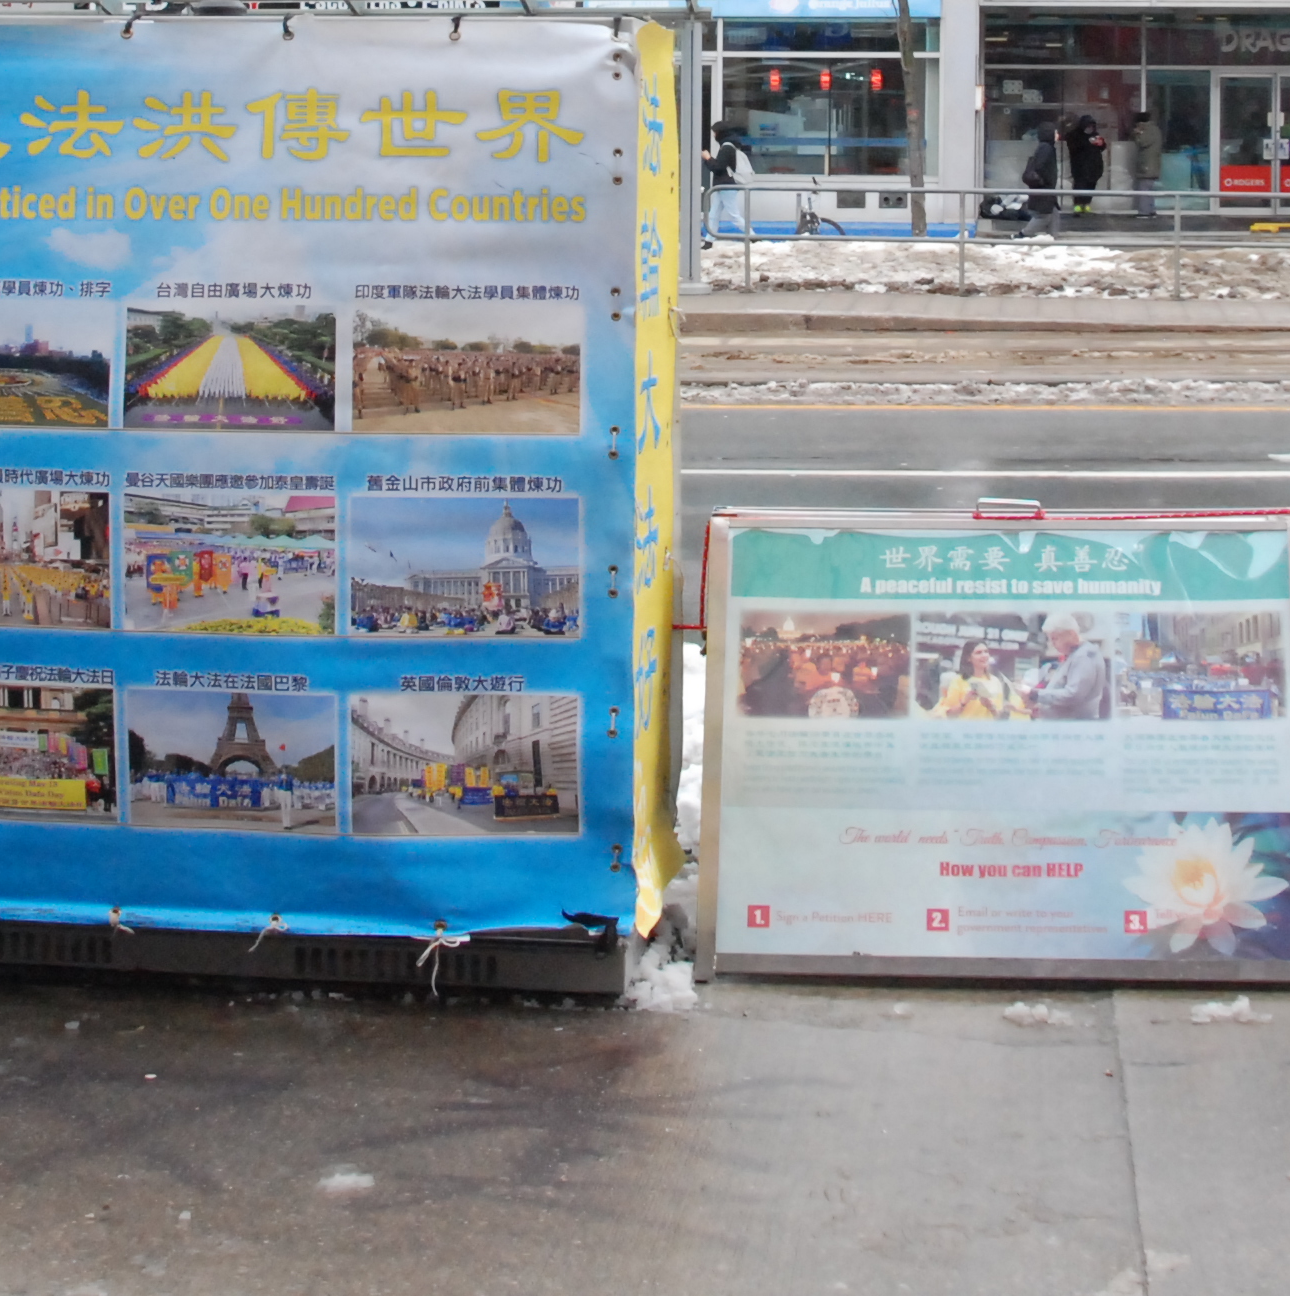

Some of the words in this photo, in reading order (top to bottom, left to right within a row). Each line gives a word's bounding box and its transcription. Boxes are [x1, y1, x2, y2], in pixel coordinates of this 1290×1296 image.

[85, 185, 114, 219] in
[123, 187, 201, 221] Over
[209, 187, 271, 221] One
[280, 186, 418, 222] Hundred
[427, 188, 587, 223] Countries
[879, 545, 1010, 573] 世界需要
[860, 577, 872, 594] A
[874, 577, 953, 596] peaceful
[956, 577, 1008, 595] resist
[1011, 578, 1029, 595] to
[1032, 580, 1074, 595] save
[1077, 579, 1162, 597] humanity
[839, 826, 870, 845] The
[874, 830, 910, 844] world
[918, 831, 949, 845] needs
[939, 862, 975, 877] How
[977, 864, 1008, 880] you
[1011, 864, 1043, 877] can
[1046, 862, 1085, 878] HELP
[754, 909, 766, 925] 1.
[776, 910, 800, 925] Sign
[811, 911, 855, 924] Petition
[858, 912, 893, 924] HERE
[931, 911, 946, 927] 2.
[957, 906, 989, 918] Email
[1128, 914, 1146, 930] 3.
[956, 923, 1023, 937] government
[1024, 923, 1109, 936] representatives
